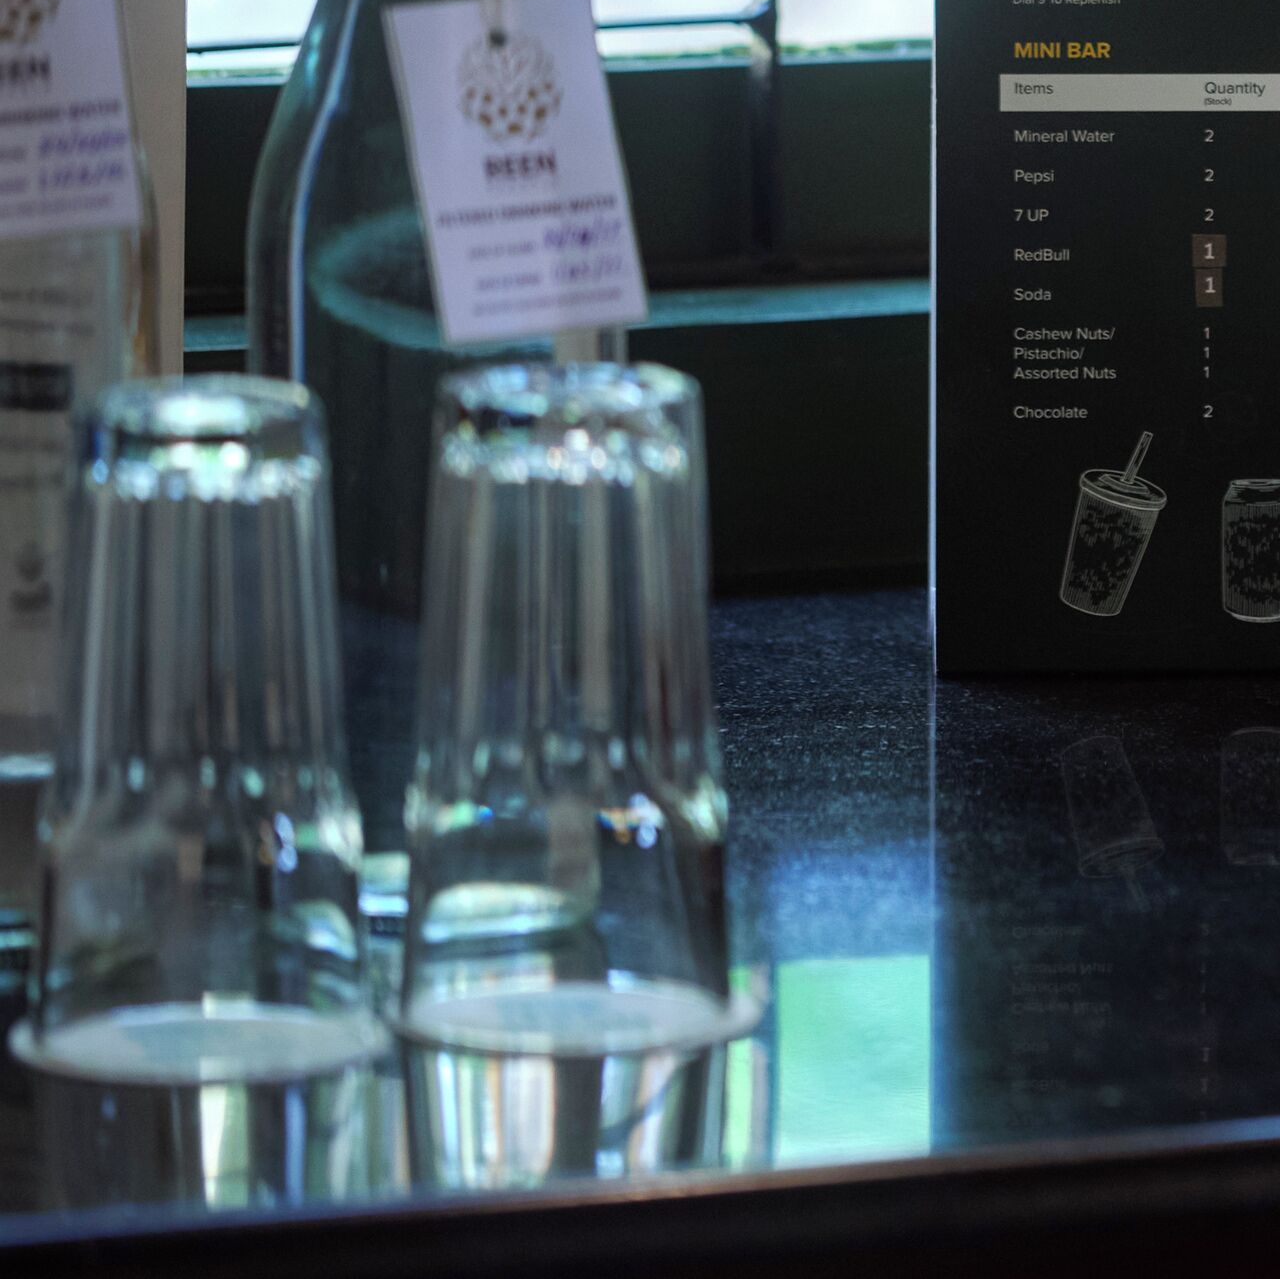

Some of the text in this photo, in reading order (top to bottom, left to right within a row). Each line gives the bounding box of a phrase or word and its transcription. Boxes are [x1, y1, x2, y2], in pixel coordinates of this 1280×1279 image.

[1014, 41, 1112, 60] MINI BAR
[1014, 82, 1055, 95] Items
[1204, 82, 1267, 99] Quantity
[1204, 97, 1233, 107] (Stock)
[1014, 129, 1069, 144] Mineral
[1072, 129, 1116, 144] Water
[1205, 129, 1216, 143] 2
[1014, 168, 1056, 186] Pepsi
[1205, 168, 1216, 182] 2
[1014, 208, 1025, 222] 7
[1028, 208, 1051, 222] UP
[1205, 208, 1216, 222] 2
[1014, 248, 1071, 262] RedBull
[1204, 243, 1216, 261] 1
[1014, 287, 1053, 302] Soda
[1205, 276, 1217, 294] 1
[1014, 326, 1211, 342] Cashew Nuts/ 1
[1014, 346, 1086, 361] Pistachio/
[1203, 346, 1211, 359] 1
[1014, 366, 1211, 380] Assorted Nuts 1
[1014, 404, 1088, 420] Chocolate
[1204, 404, 1215, 418] 2
